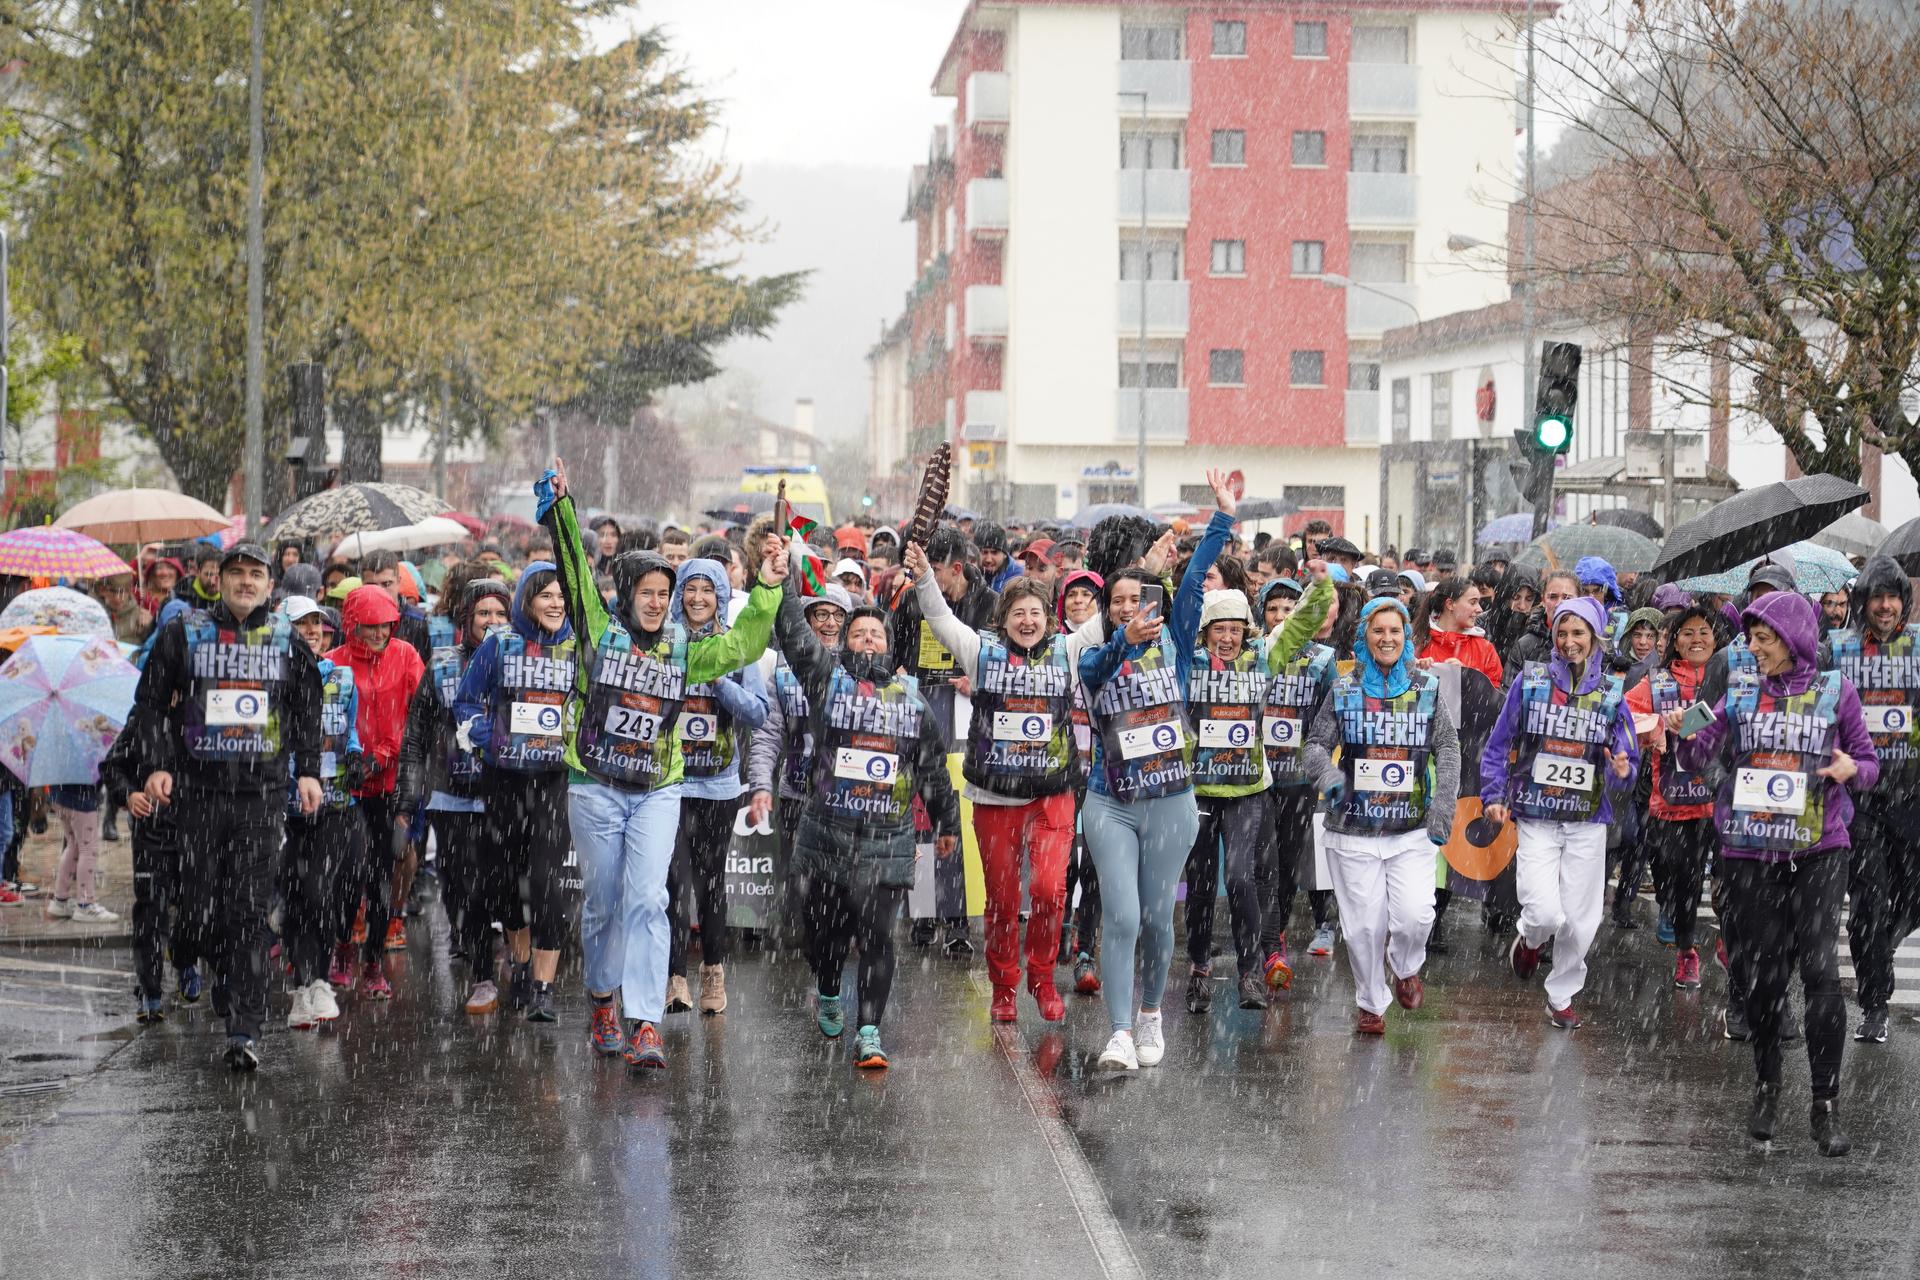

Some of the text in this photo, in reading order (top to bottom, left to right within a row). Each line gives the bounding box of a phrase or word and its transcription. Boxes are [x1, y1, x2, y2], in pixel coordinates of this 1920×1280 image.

[194, 642, 281, 679] HITZEKIN
[504, 655, 574, 692] HITZEKI
[600, 648, 682, 700] HITZEKIN
[984, 661, 1066, 697] HITZEKIN
[1101, 665, 1182, 716] HITZEKIN
[1189, 669, 1267, 704] HITZEKIN
[614, 711, 655, 740] 243
[831, 693, 919, 739] HITZEKIN
[1343, 710, 1428, 746] HITZEKIN
[1527, 700, 1608, 744] HITZEKIN
[194, 733, 274, 753] 22.korrika
[527, 737, 546, 748] aek
[1736, 711, 1828, 755] HITZEKIN
[585, 743, 662, 775] 22.korrika
[616, 743, 639, 755] aek
[984, 750, 1060, 768] 22.korrika
[1213, 751, 1233, 763] aek
[1116, 760, 1190, 792] 22.korrik
[1143, 758, 1164, 772] aek
[1545, 763, 1586, 785] 243
[824, 788, 901, 815] 22.korrika
[851, 784, 874, 797] aek
[1515, 789, 1591, 812] 22.korrika
[1344, 799, 1418, 819] 22.korrika
[1722, 815, 1812, 843] 22.korrika
